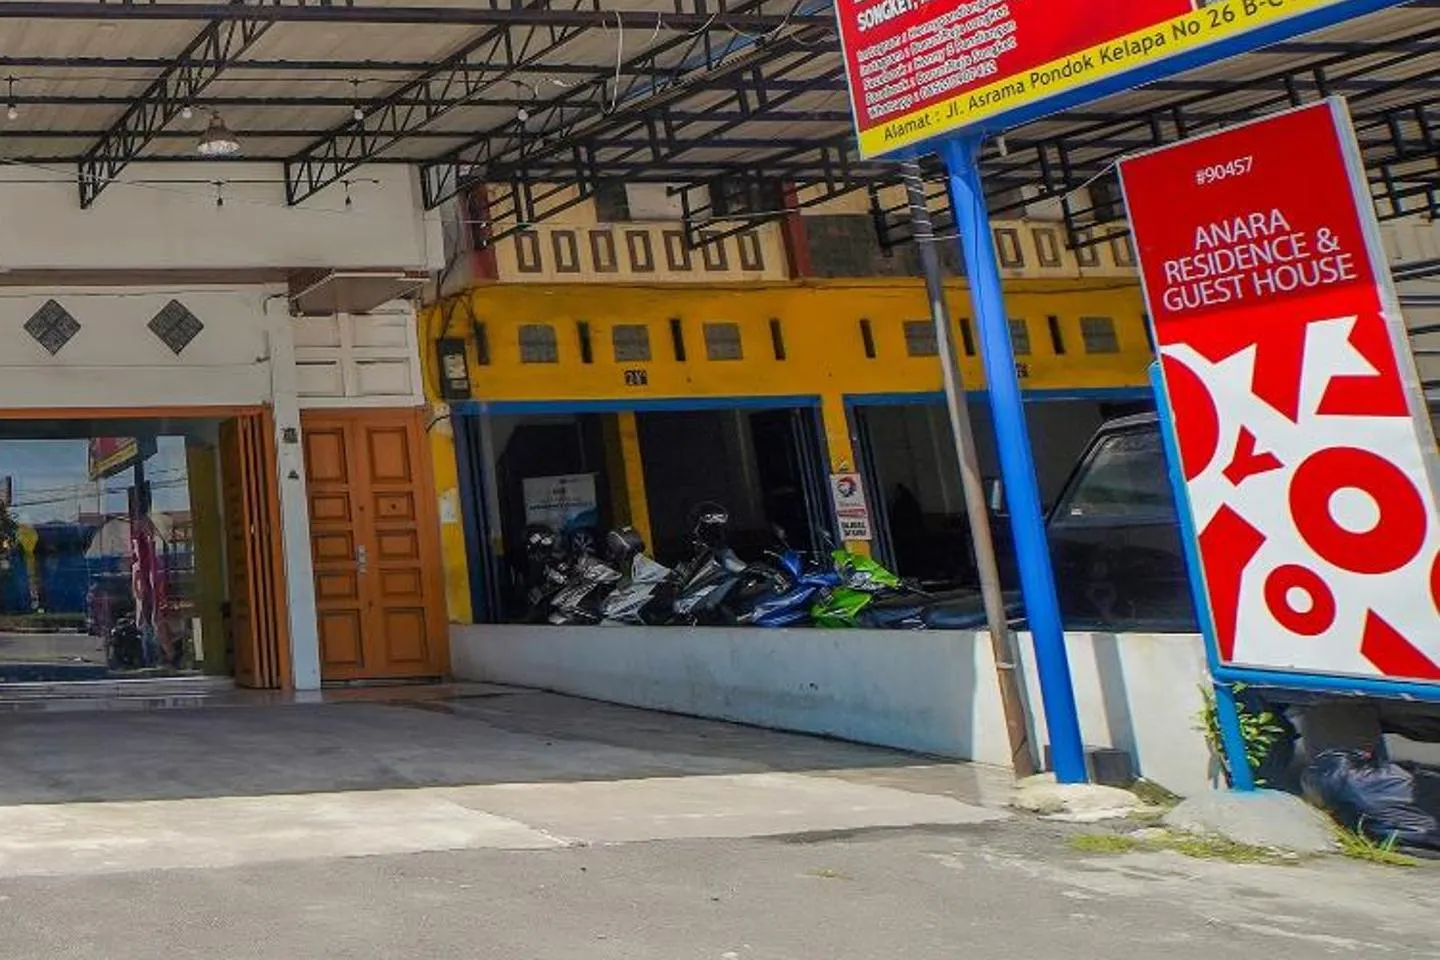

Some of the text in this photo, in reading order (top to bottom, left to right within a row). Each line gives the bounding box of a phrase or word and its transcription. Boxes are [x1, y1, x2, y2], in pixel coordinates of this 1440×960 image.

[883, 113, 932, 141] Alamat
[968, 81, 1026, 111] Asrama
[1030, 55, 1094, 89] Pondok
[1099, 32, 1167, 66] Kelapa
[1171, 19, 1201, 40] No
[1207, 7, 1236, 28] 26
[1196, 155, 1254, 185] #90457
[1164, 227, 1341, 285] RESIDENCE &
[1195, 208, 1291, 251] ANARA
[1163, 253, 1358, 312] GUEST HOUSE
